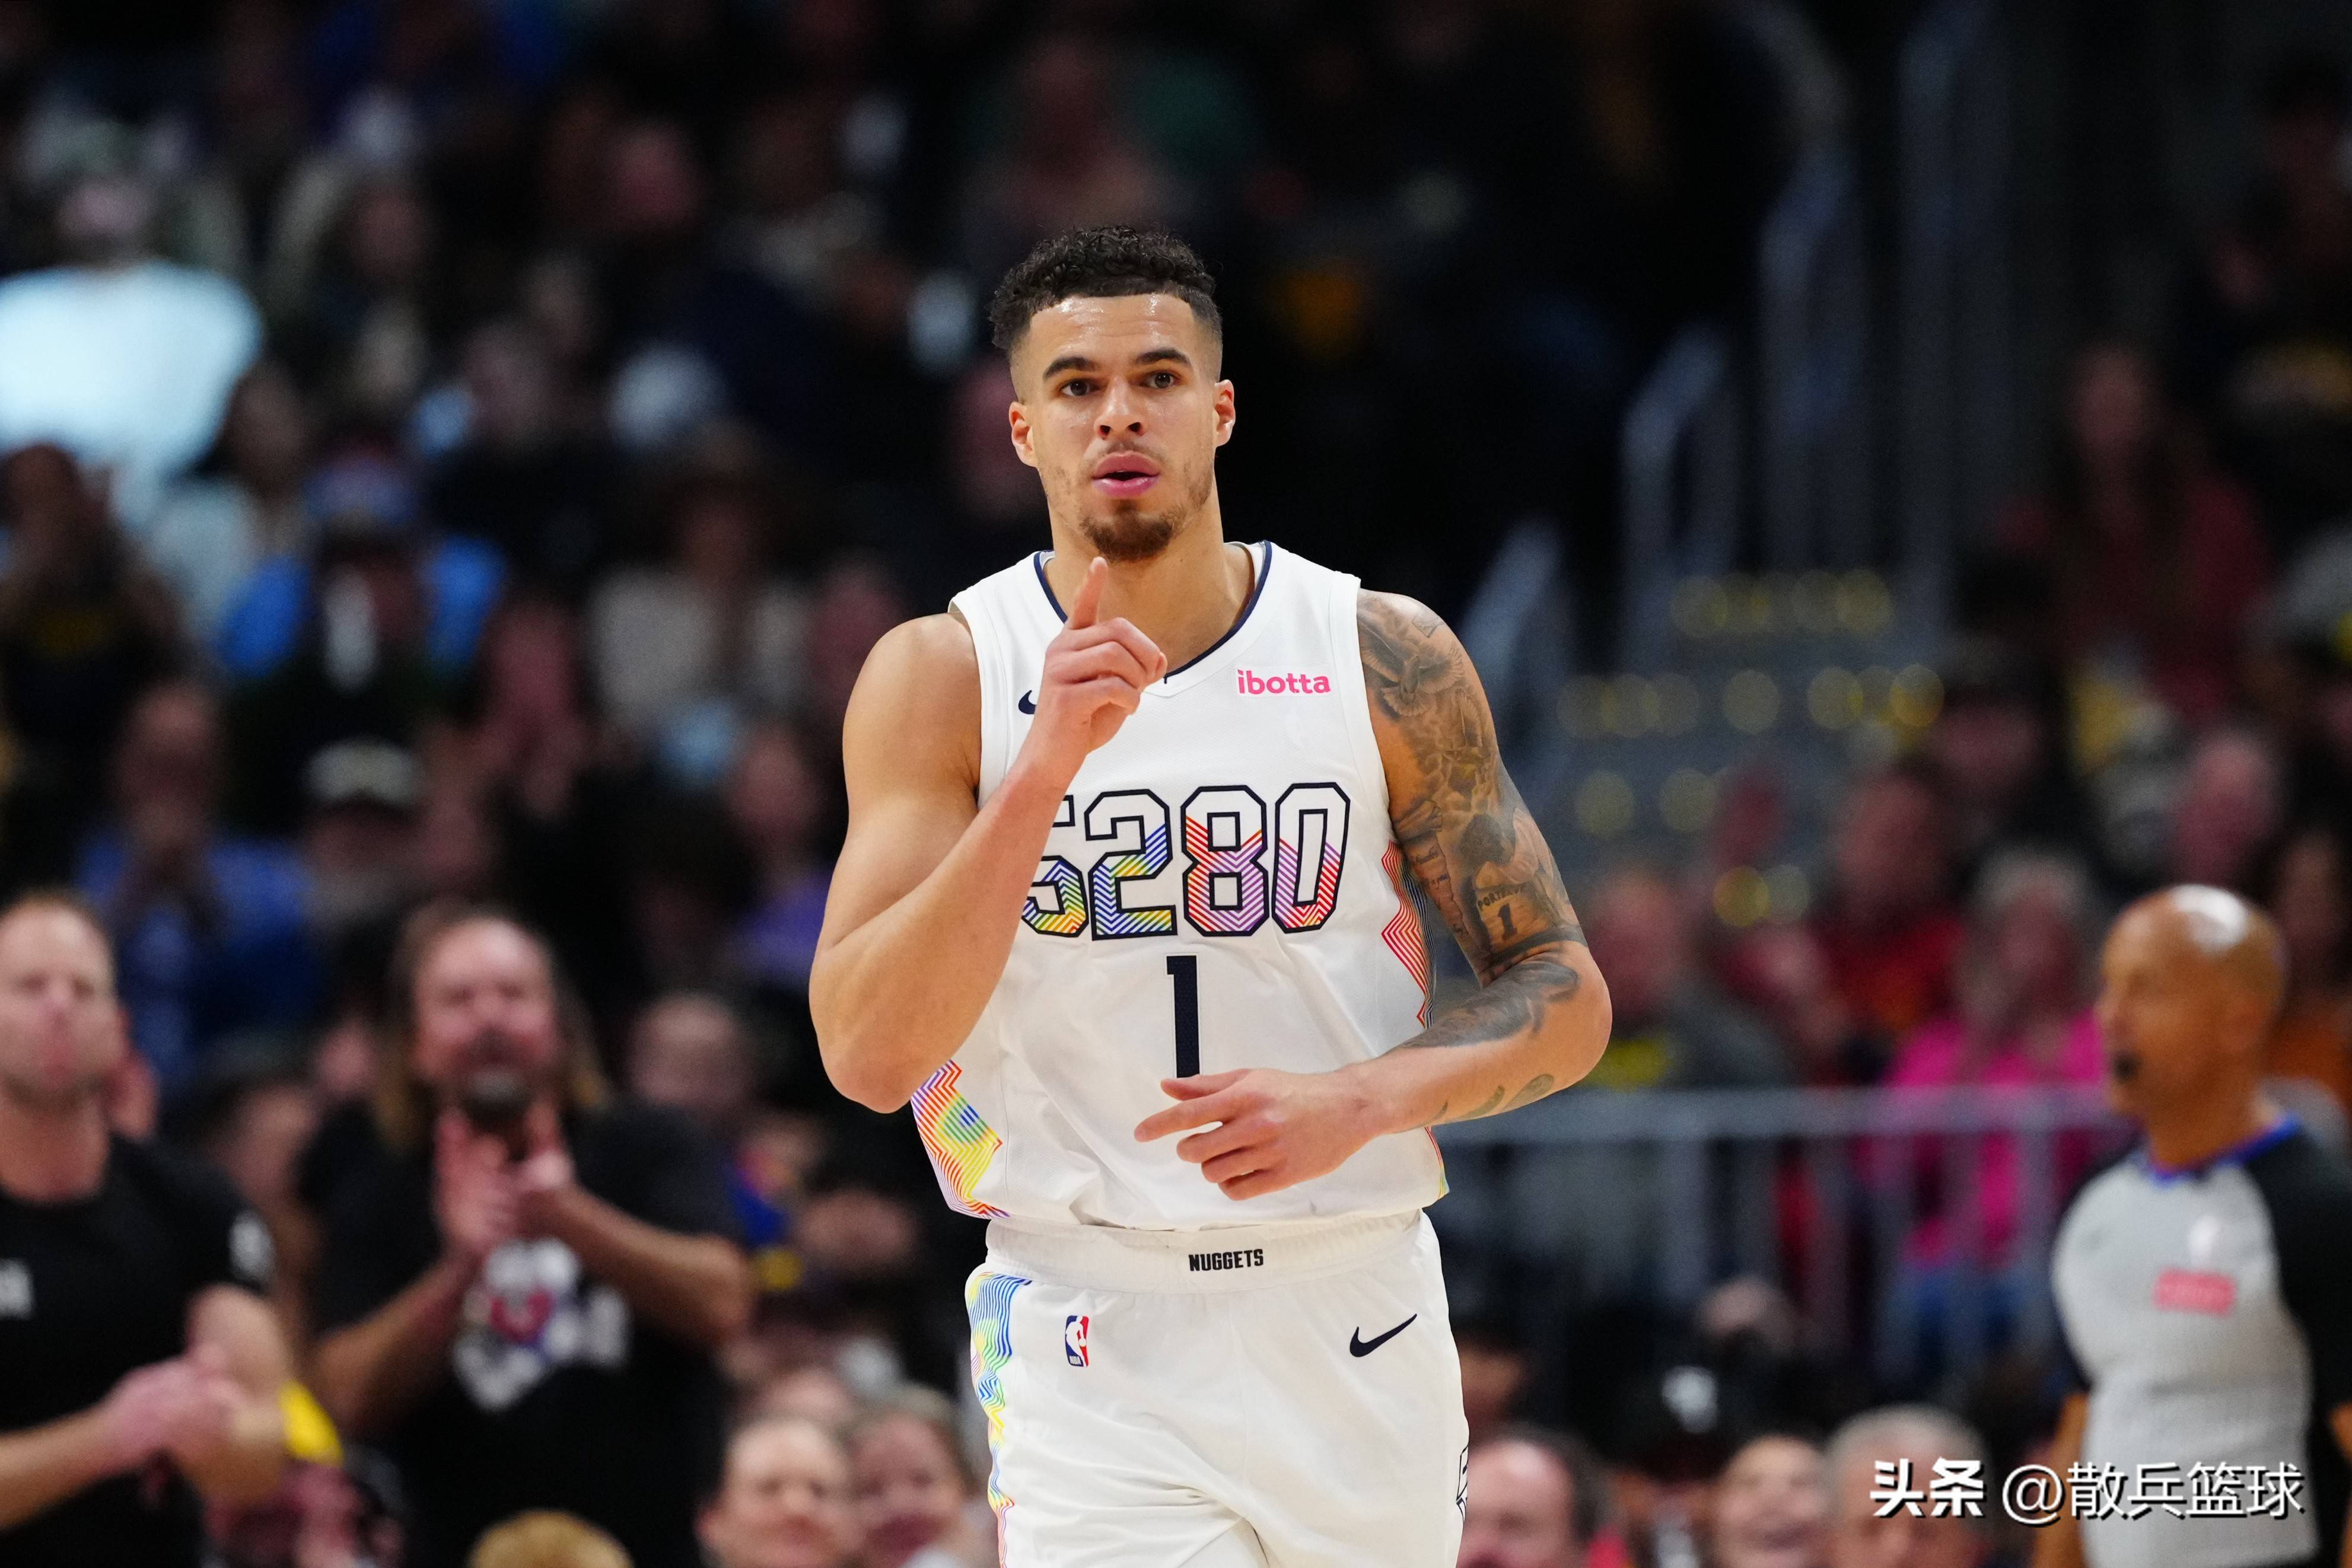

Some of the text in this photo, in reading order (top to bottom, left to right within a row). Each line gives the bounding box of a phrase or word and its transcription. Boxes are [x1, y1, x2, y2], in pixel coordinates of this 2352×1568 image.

[1237, 668, 1331, 695] ibotta
[1020, 782, 1351, 941] 5280
[1498, 903, 1517, 941] 1
[1166, 955, 1201, 1078] 1
[1188, 1248, 1264, 1271] NUGGETS
[1068, 1355, 1081, 1365] NBA
